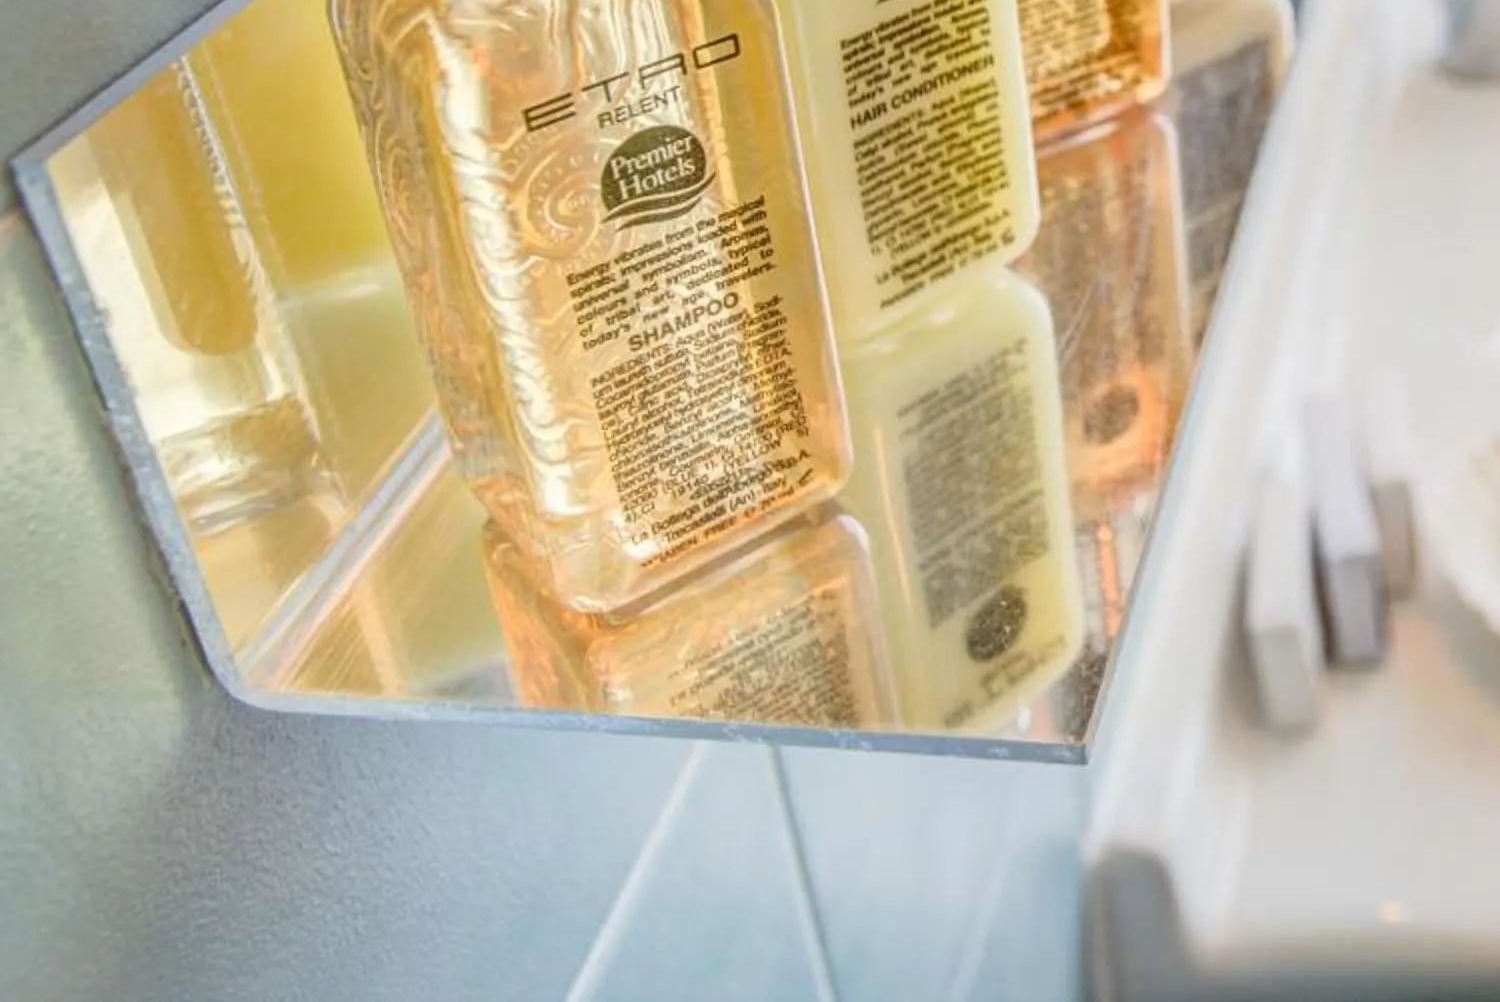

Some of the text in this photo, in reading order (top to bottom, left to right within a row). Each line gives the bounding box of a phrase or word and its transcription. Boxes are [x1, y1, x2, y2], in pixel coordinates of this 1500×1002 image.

[598, 86, 682, 129] RELENT
[851, 102, 886, 127] HAIR
[891, 53, 993, 110] CONDITIONER
[609, 134, 694, 181] Premier
[616, 156, 697, 201] Hotels
[566, 261, 609, 285] Energy
[613, 239, 662, 264] vibrates
[665, 226, 693, 243] from
[697, 216, 715, 230] the
[697, 221, 736, 243] loaded
[572, 281, 629, 310] universal
[576, 296, 626, 323] colours
[634, 282, 657, 298] and
[729, 234, 771, 258] typical
[579, 324, 592, 337] of
[606, 304, 640, 324] tribal
[686, 257, 748, 290] dedicated
[760, 246, 773, 258] to
[582, 323, 629, 350] today's
[643, 306, 669, 322] new
[681, 290, 704, 305] age
[627, 290, 739, 353] SHAMPOO
